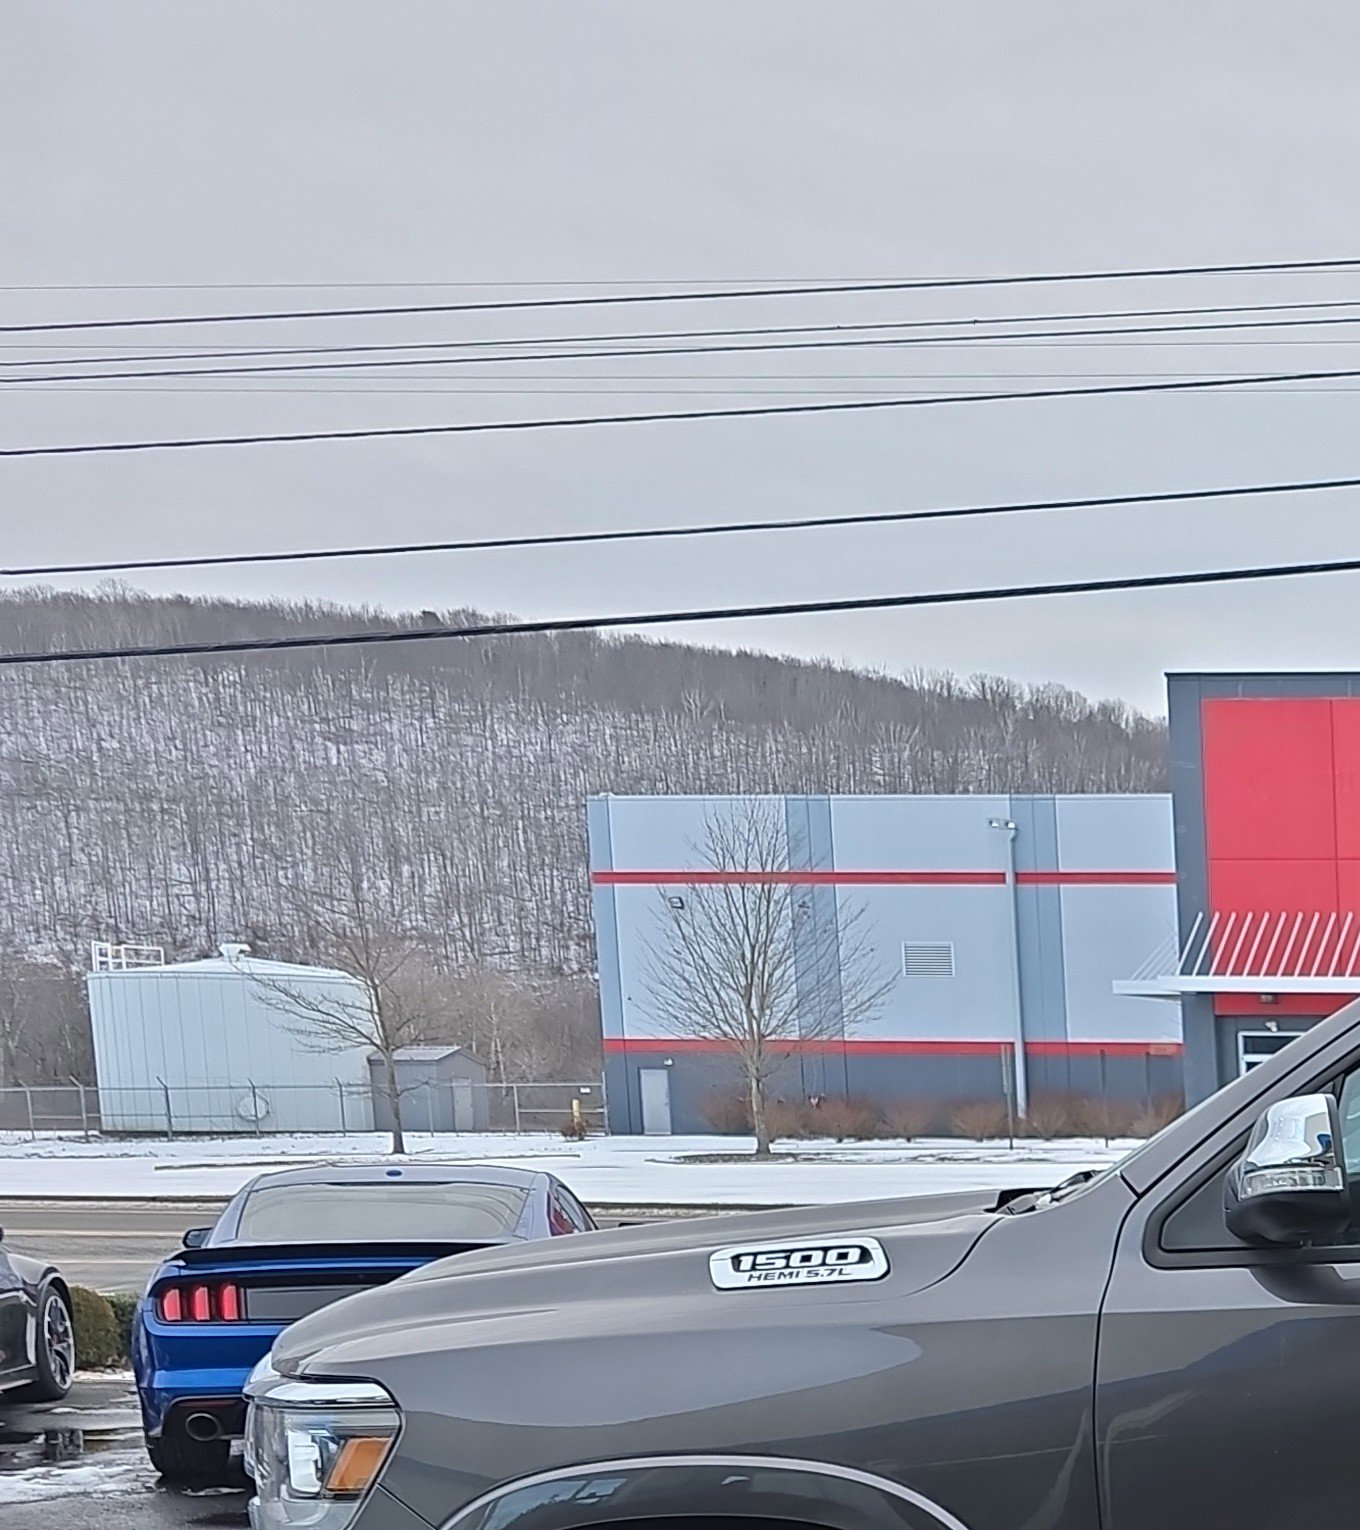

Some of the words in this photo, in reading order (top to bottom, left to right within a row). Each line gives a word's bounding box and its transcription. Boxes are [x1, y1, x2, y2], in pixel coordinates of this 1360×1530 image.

[739, 1247, 861, 1271] 1500
[747, 1271, 800, 1282] HEMI
[805, 1267, 852, 1279] 5.7L
